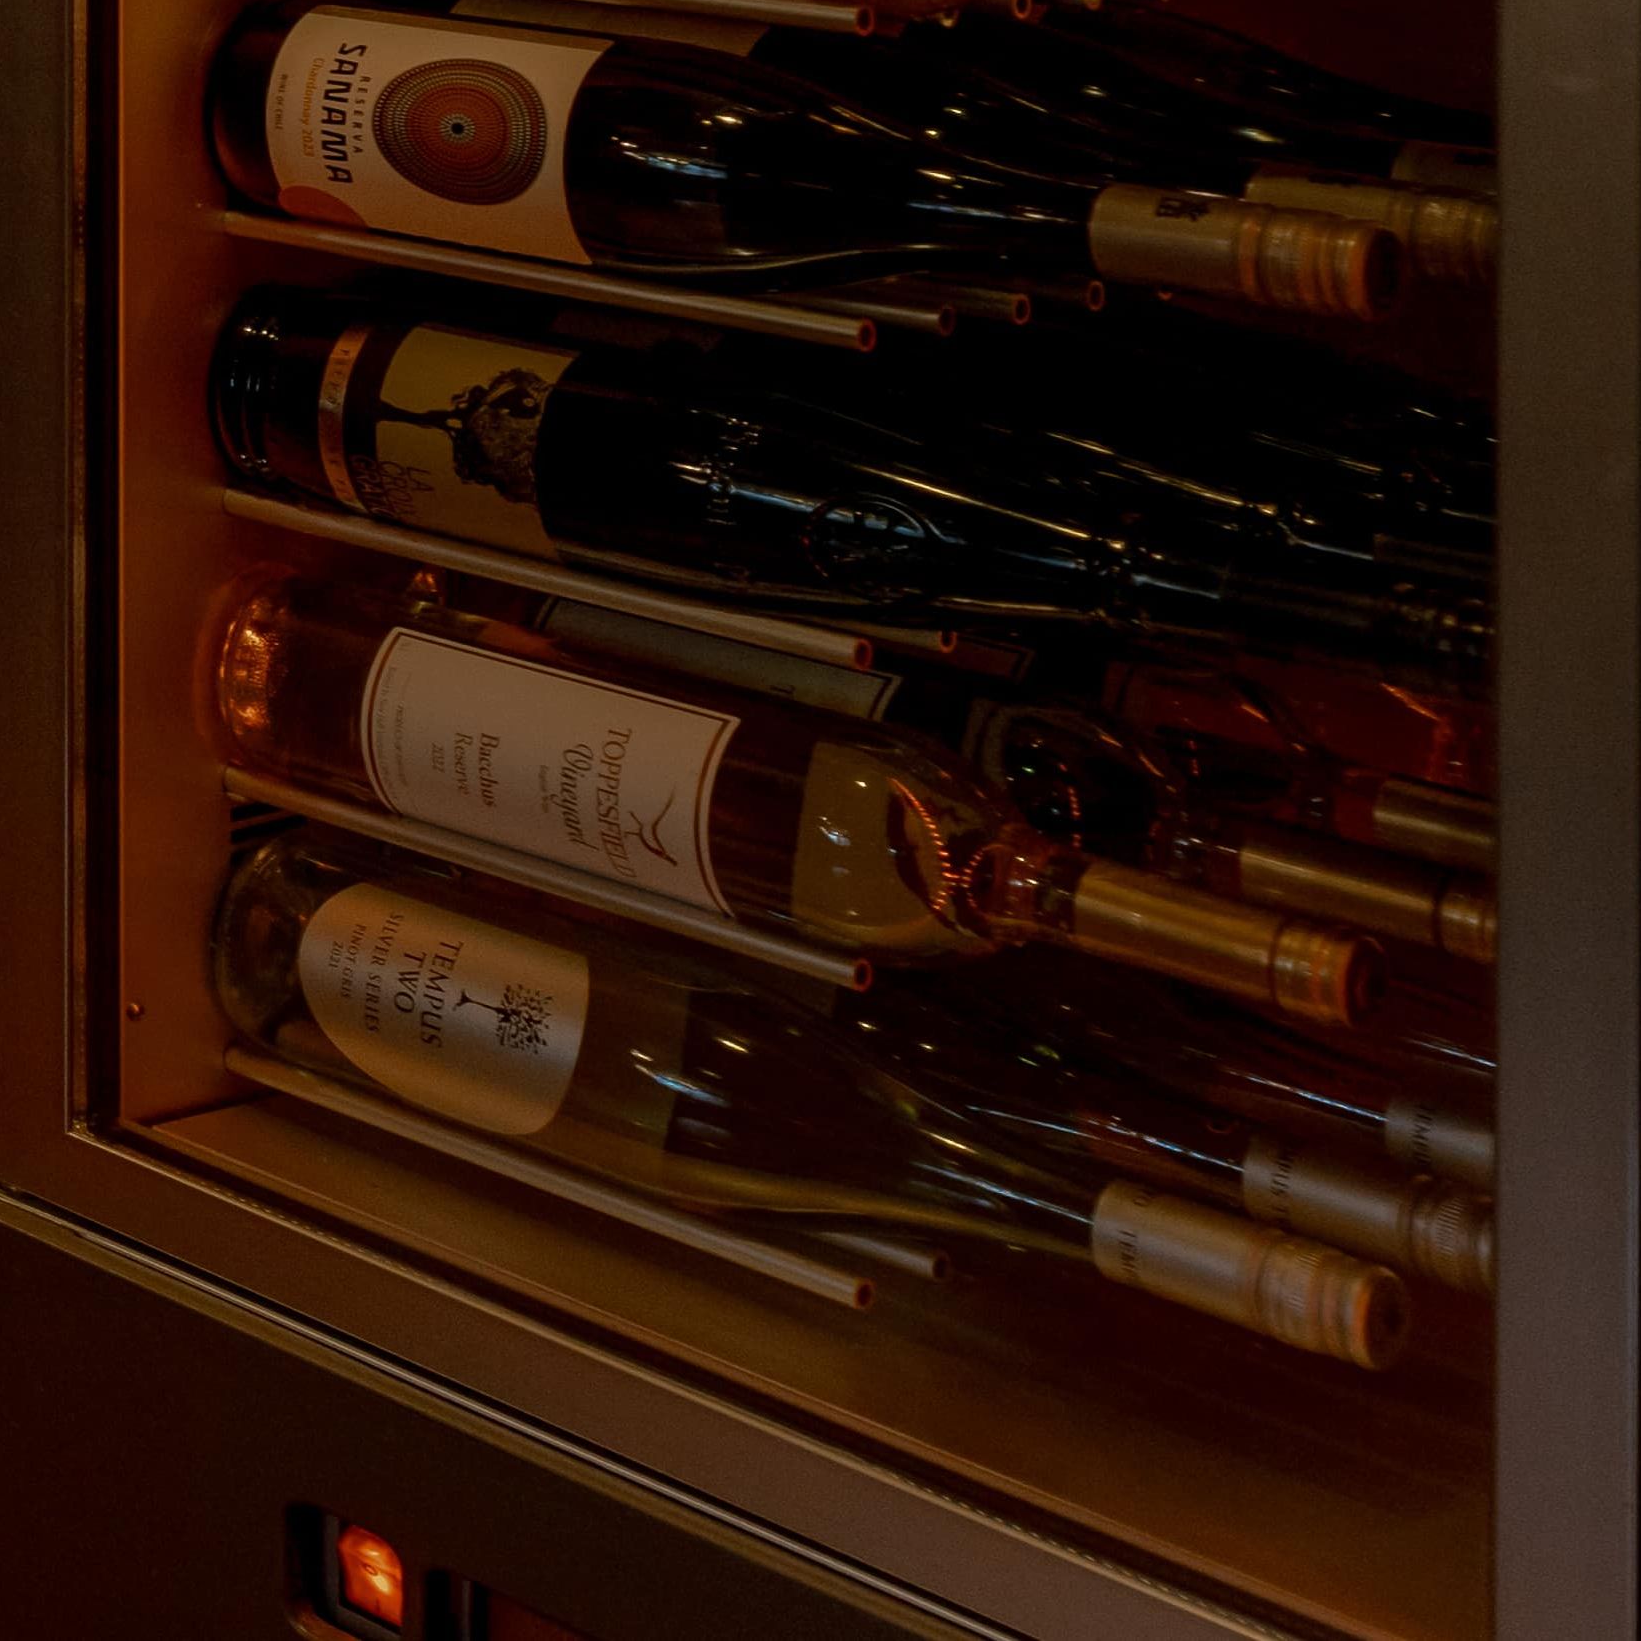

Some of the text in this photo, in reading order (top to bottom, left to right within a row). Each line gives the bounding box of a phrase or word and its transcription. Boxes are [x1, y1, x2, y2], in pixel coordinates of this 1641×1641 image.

[299, 57, 326, 126] Chardonnay
[321, 43, 367, 183] SANAMA
[352, 75, 372, 155] RESERVA
[407, 467, 435, 492] LA
[453, 731, 473, 795] Reserve
[475, 733, 500, 808] Bacchus
[547, 744, 599, 851] Vineyard
[597, 728, 637, 878] TOPPESFIELD
[345, 923, 367, 962] PINOT
[364, 913, 403, 1032] SILVER SERIES
[394, 951, 427, 1013] TWO
[420, 940, 464, 1048] TEMPUS
